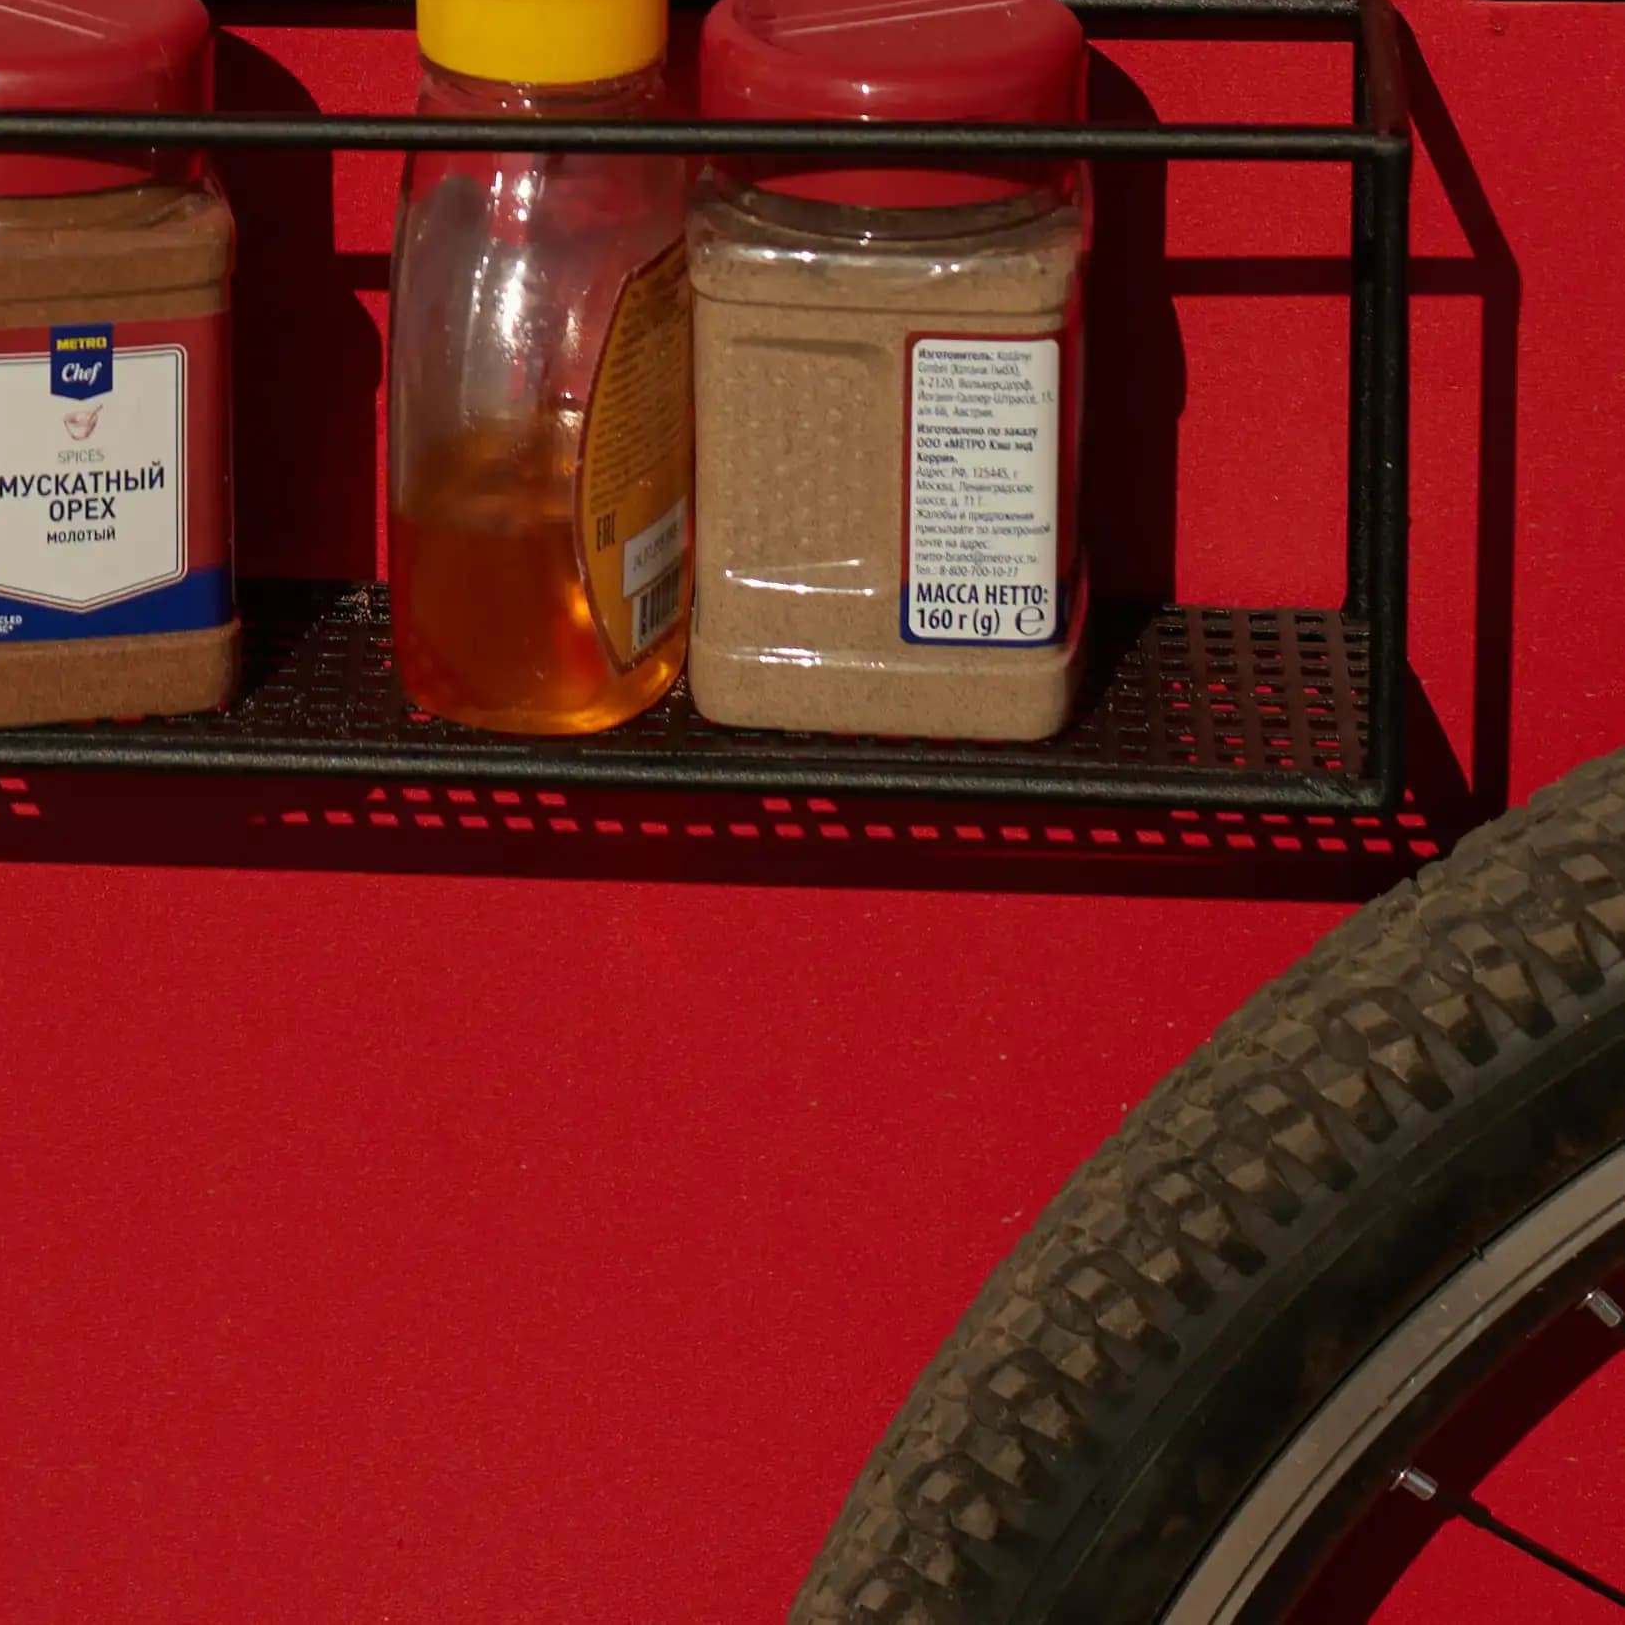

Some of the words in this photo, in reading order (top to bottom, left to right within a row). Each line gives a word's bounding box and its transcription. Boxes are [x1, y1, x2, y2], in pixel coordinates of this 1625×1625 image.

[56, 336, 107, 351] METRO
[61, 361, 103, 386] Chef
[916, 438, 941, 449] ООО
[57, 449, 105, 464] SPICES
[49, 497, 116, 522] ОРЕХ
[917, 583, 979, 604] МАССА
[986, 585, 1048, 606] НЕТТО:
[917, 608, 953, 630] 160
[973, 608, 1000, 636] (g)
